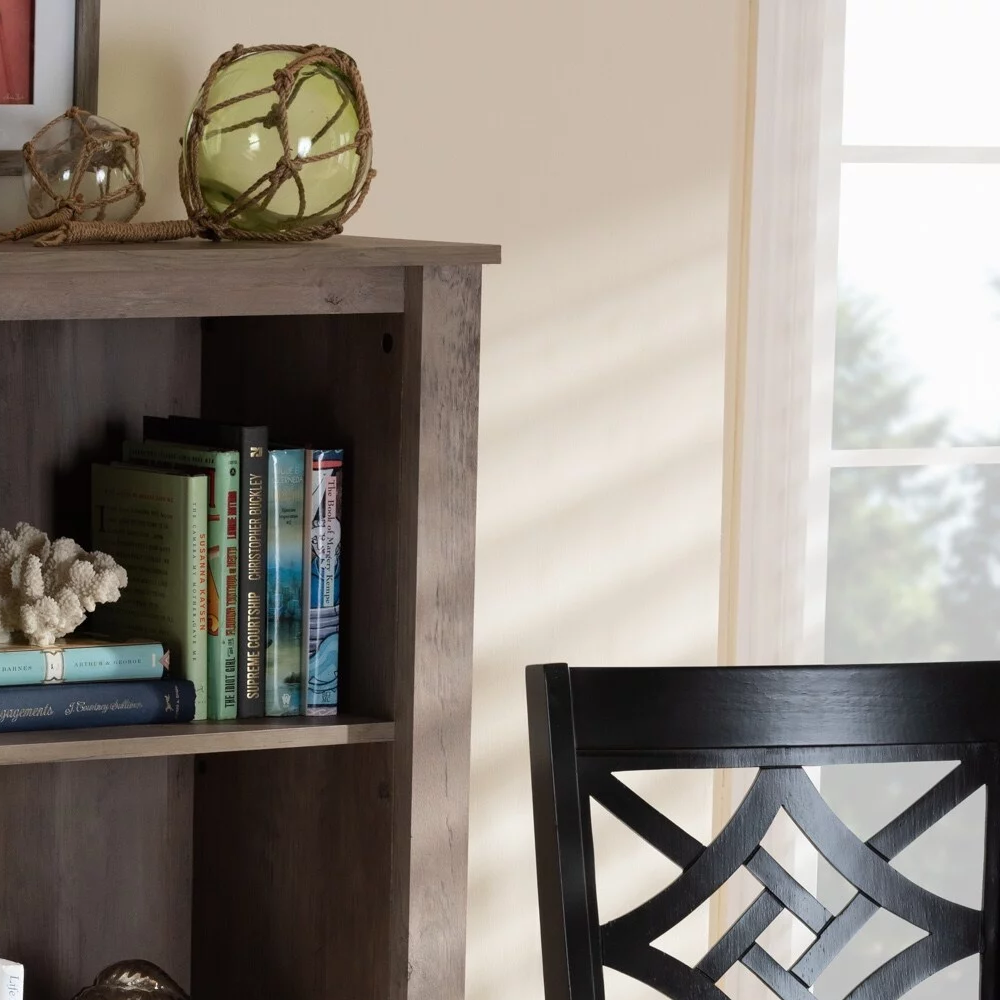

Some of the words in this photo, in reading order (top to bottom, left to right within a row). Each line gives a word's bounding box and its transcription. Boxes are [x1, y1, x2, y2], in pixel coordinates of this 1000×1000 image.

[249, 473, 262, 516] BUCKLEY
[328, 479, 336, 496] The
[327, 500, 336, 520] Book
[327, 525, 336, 535] of
[248, 519, 262, 580] CHRISTOPHER
[324, 536, 334, 569] Margery
[192, 565, 197, 576] MY
[325, 574, 334, 603] Kempe
[247, 592, 261, 648] COURTSHIP
[192, 650, 197, 661] ME
[225, 656, 236, 673] GIRL
[2, 664, 33, 673] BARNES
[246, 651, 260, 699] SUPREME
[224, 675, 236, 693] IDIOT
[224, 694, 236, 708] THE
[7, 975, 20, 997] Life
